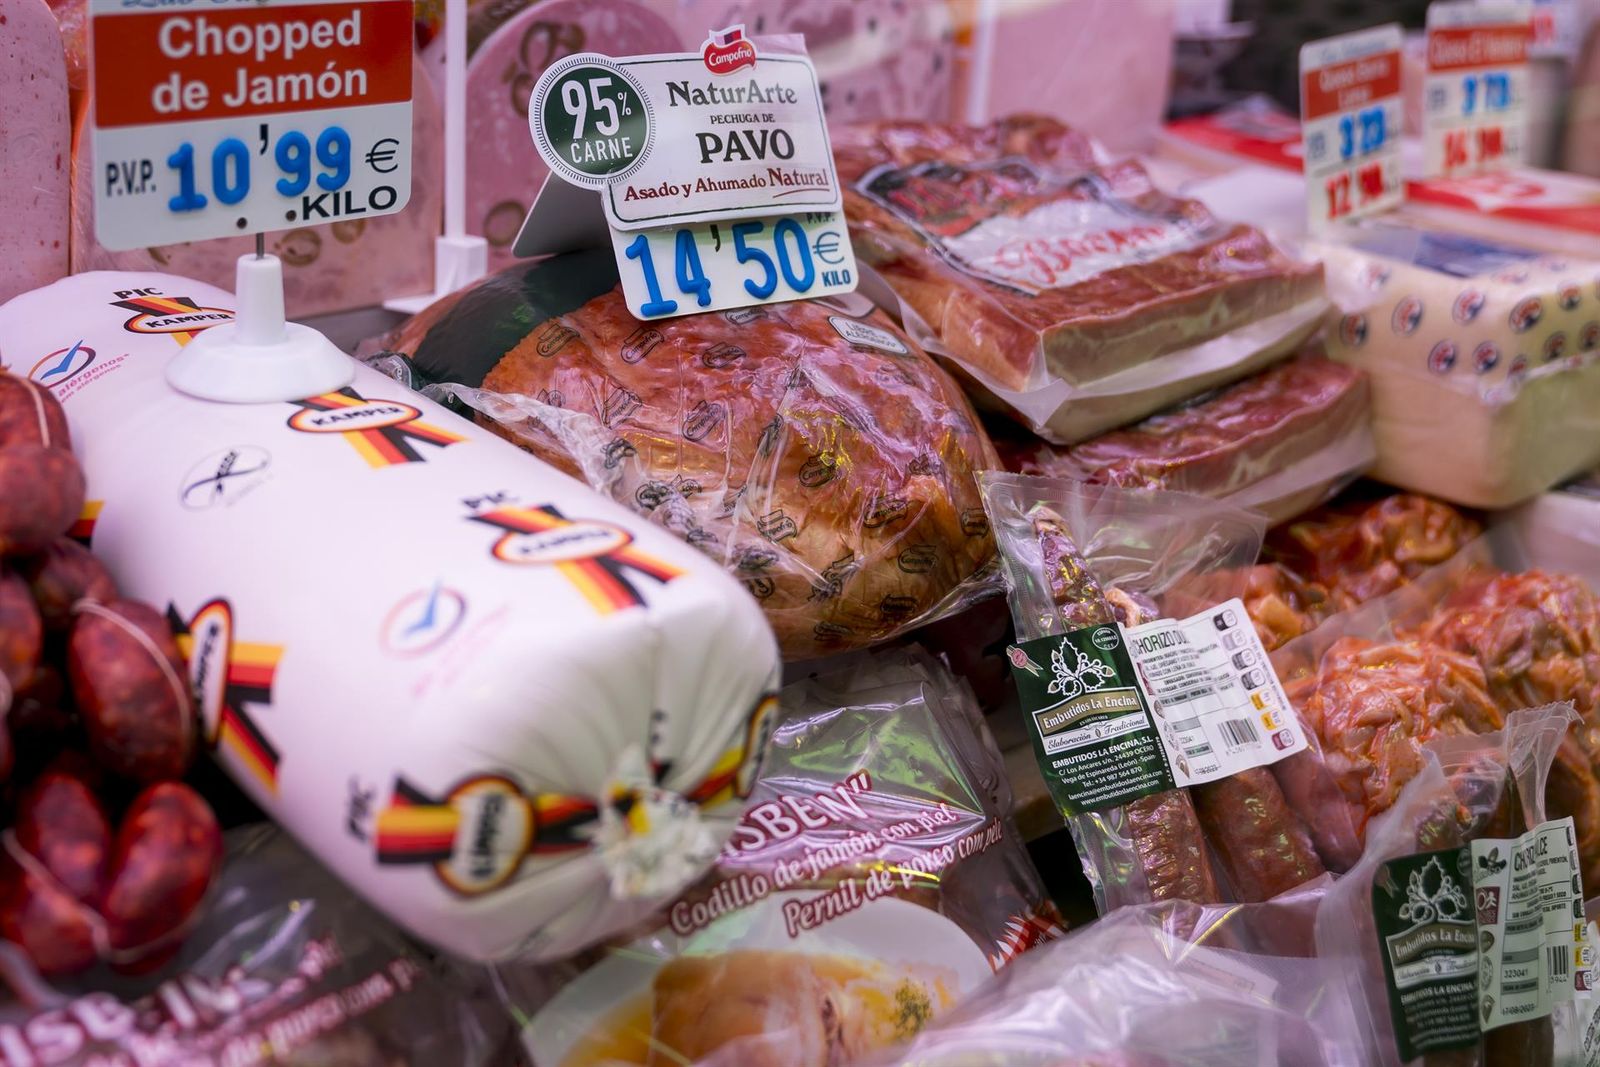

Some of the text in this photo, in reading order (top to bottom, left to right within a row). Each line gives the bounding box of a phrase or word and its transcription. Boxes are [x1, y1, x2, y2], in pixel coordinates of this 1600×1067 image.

[159, 10, 361, 61] Chopped
[152, 62, 367, 113] de Jamón
[666, 79, 797, 107] NaturArte
[710, 112, 776, 125] PECHUGA DE
[570, 136, 634, 164] CARNE
[696, 128, 795, 164] PAVO
[105, 159, 157, 197] P.V.P.
[365, 138, 400, 174] €
[624, 167, 829, 202] Asado y Ahumado Natural
[302, 185, 398, 220] KILO
[812, 231, 845, 265] €
[821, 269, 851, 288] KILO
[113, 287, 163, 299] PIC
[146, 312, 232, 328] KAMPER
[312, 404, 404, 427] KAMPER
[1043, 702, 1090, 729] Embutidos
[1090, 699, 1103, 709] La
[1104, 695, 1138, 708] Encina
[1047, 732, 1092, 750] Elaboración
[1104, 715, 1146, 735] Tradicional
[1052, 750, 1098, 769] EMBUTIDOS
[1098, 748, 1109, 757] LA
[1067, 766, 1078, 774] Los
[1078, 760, 1102, 772] Ancares
[1114, 749, 1134, 762] 24439
[1062, 774, 1077, 785] Vega
[1077, 773, 1086, 781] de
[1086, 764, 1118, 779] Espinareda
[1106, 772, 1118, 782] 987
[1118, 769, 1131, 779] 564
[1130, 765, 1143, 775] 870
[1081, 779, 1160, 806] www.embutidoslaencina.com
[671, 801, 958, 933] Codillo de jamón con piel
[784, 873, 864, 935] Pernil
[865, 866, 895, 899] de
[898, 845, 955, 891] porco
[958, 829, 984, 859] com
[1439, 928, 1452, 940] La
